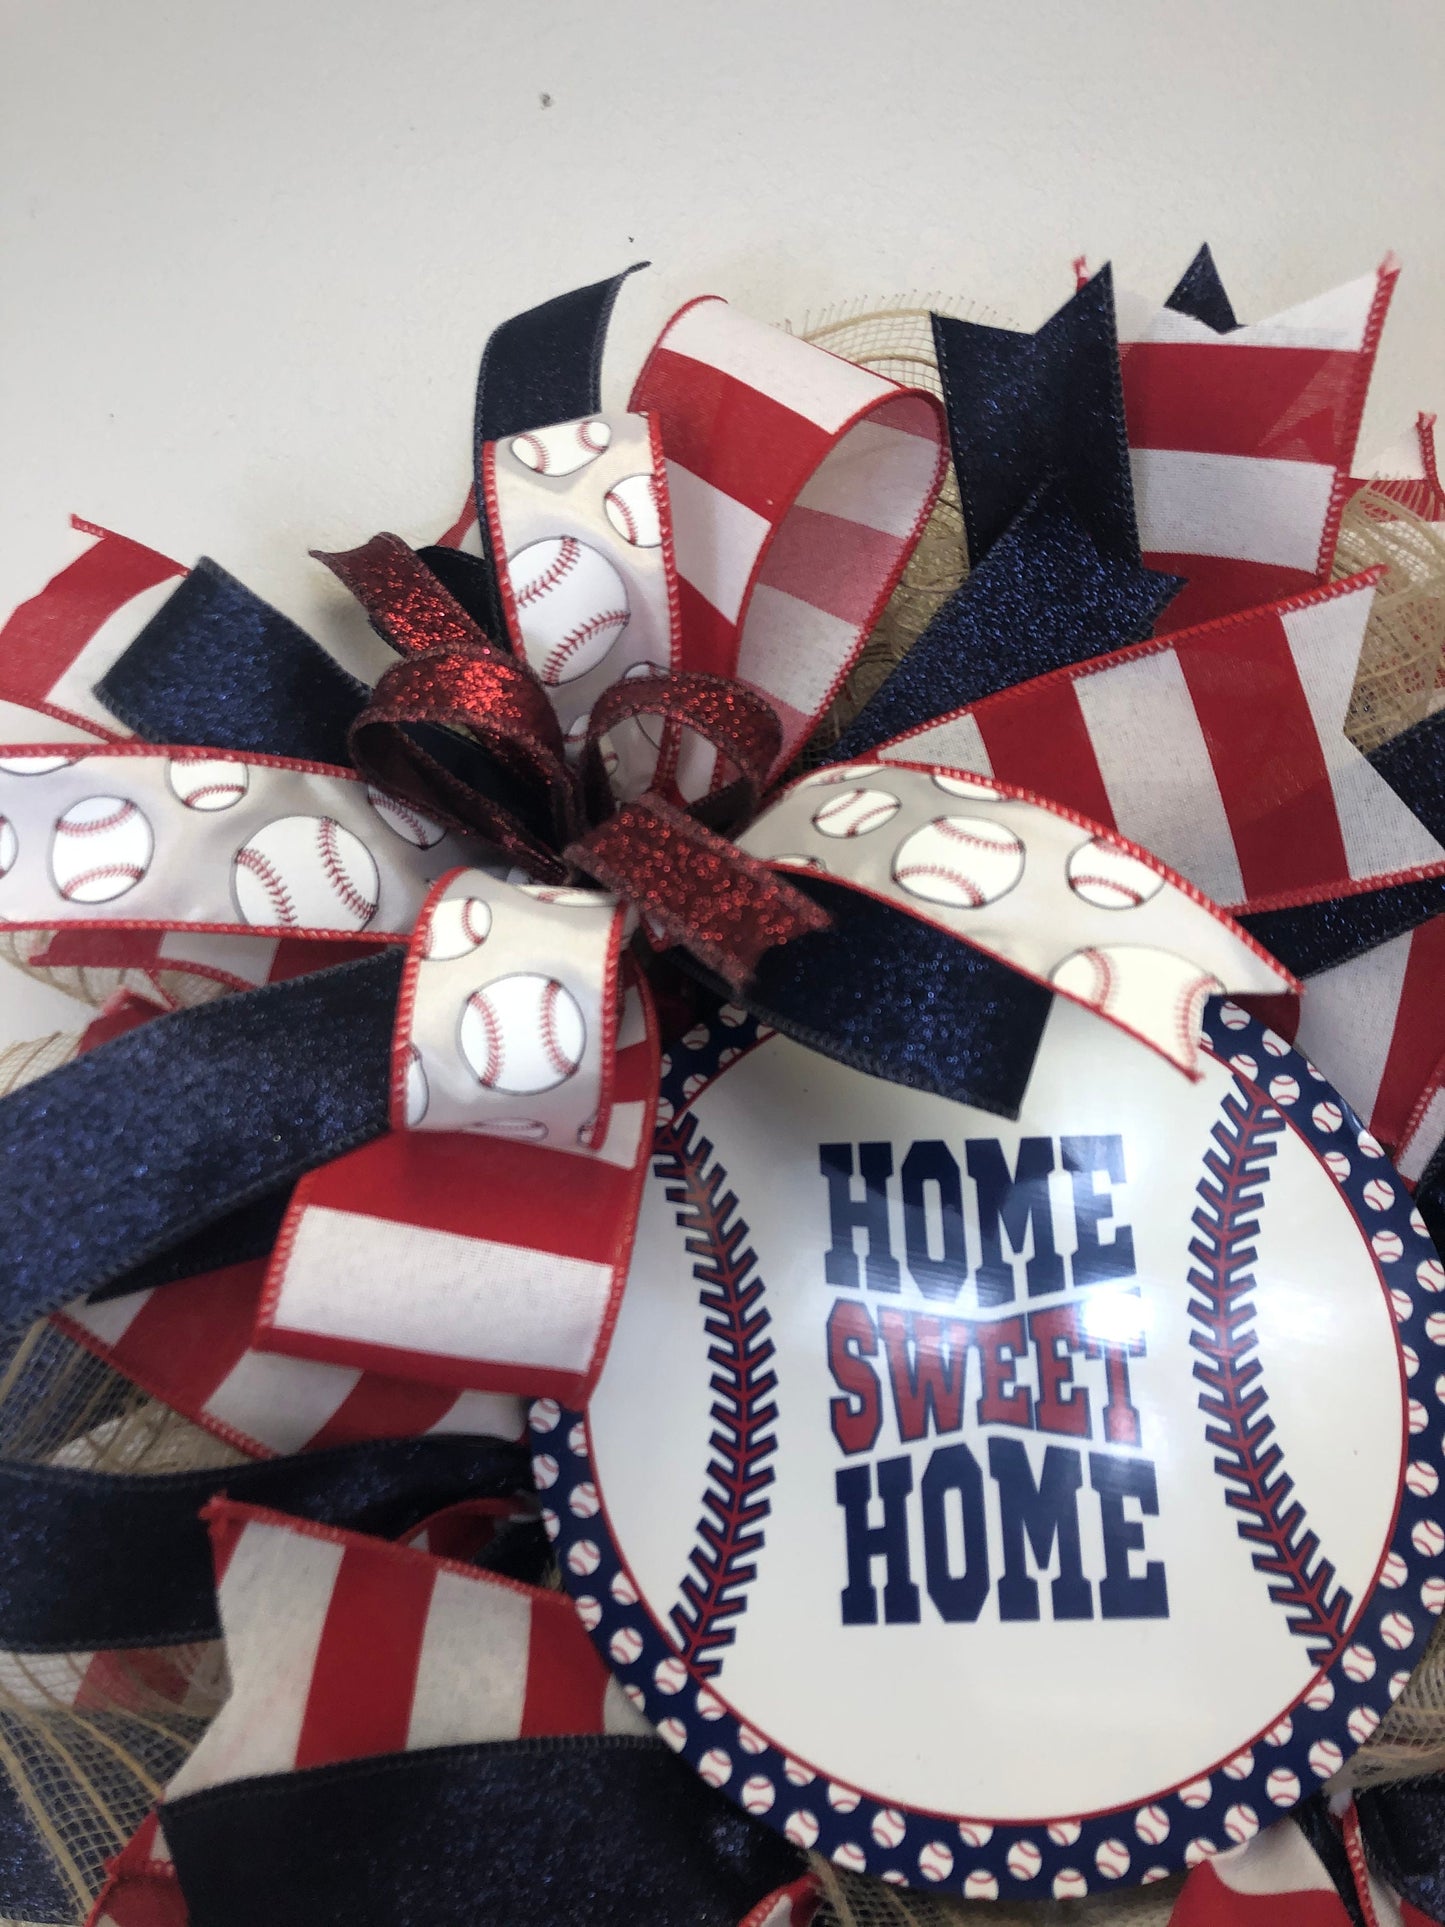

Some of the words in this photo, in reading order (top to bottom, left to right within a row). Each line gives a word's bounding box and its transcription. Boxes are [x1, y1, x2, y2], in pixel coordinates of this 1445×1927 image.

[819, 1134, 1137, 1307] HOME
[826, 1287, 1147, 1456] SWEET
[835, 1436, 1170, 1626] HOME
